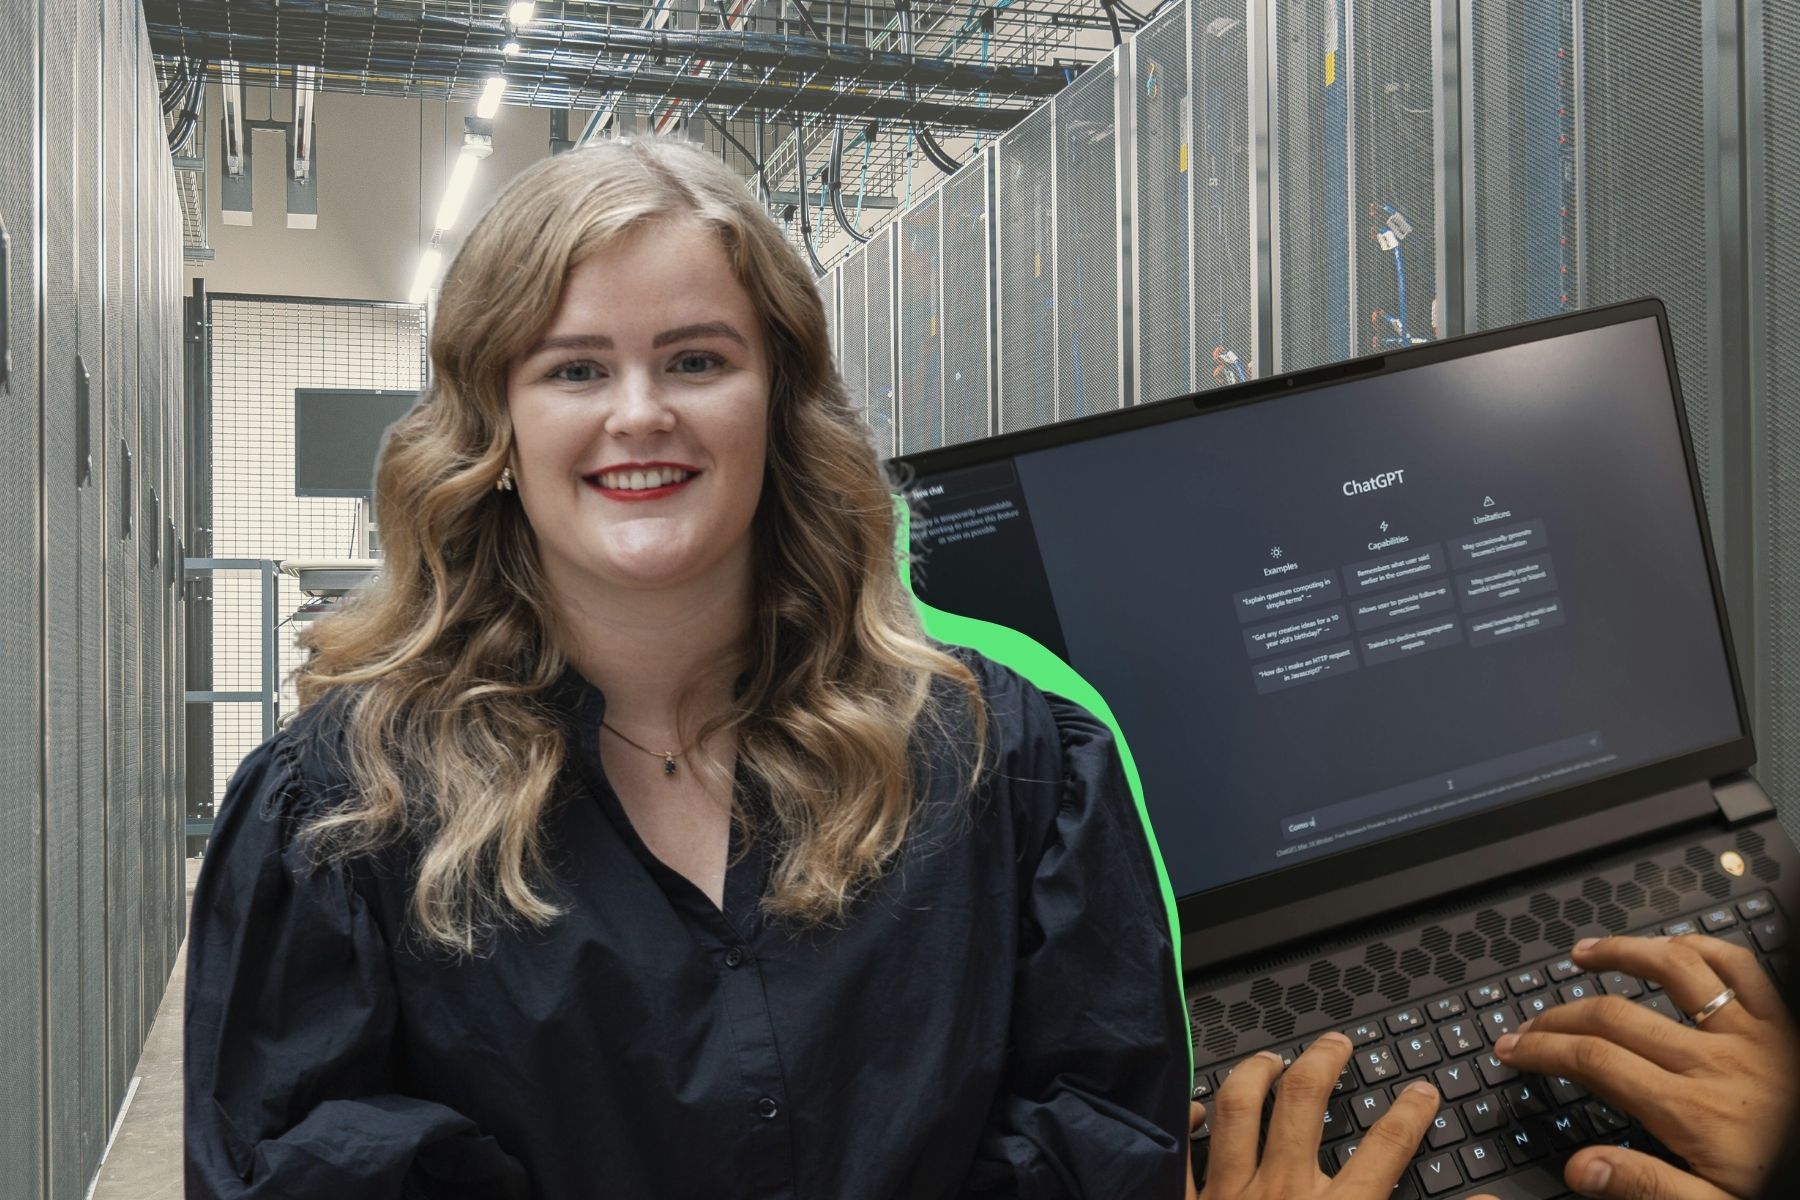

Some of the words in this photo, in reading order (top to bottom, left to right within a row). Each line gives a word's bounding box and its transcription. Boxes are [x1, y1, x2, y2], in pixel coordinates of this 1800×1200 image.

[1343, 469, 1404, 496] ChatGPT
[929, 485, 944, 496] chat
[1473, 510, 1511, 525] Limitations
[1367, 535, 1409, 550] Capabilities
[1263, 562, 1298, 576] Examples
[1357, 564, 1391, 577] Remembers
[1390, 560, 1405, 569] what
[1417, 553, 1430, 562] said
[1361, 576, 1379, 586] earlier
[1385, 572, 1396, 580] the
[1242, 595, 1266, 606] "Explain
[1266, 588, 1292, 600] quantum
[1292, 581, 1324, 593] computing
[1324, 578, 1331, 586] in
[1266, 599, 1285, 610] simple
[1285, 594, 1305, 605] terms"
[1358, 605, 1377, 615] Allows
[1377, 602, 1390, 610] user
[1397, 594, 1419, 606] provide
[1252, 632, 1266, 641] "Got
[1267, 630, 1278, 639] any
[1278, 624, 1300, 635] creative
[1300, 620, 1317, 630] ideas
[1316, 617, 1326, 626] for
[1265, 640, 1279, 649] year
[1368, 638, 1389, 650] Trained
[1259, 669, 1275, 678] "How
[1275, 666, 1284, 674] do
[1288, 661, 1304, 670] make
[1312, 654, 1328, 664] HTTP
[1328, 648, 1351, 660] request
[1283, 674, 1291, 682] in
[1288, 823, 1309, 832] Como
[1533, 999, 1544, 1010] 9
[1493, 1012, 1504, 1023] 8
[1452, 1025, 1461, 1037] 7
[1411, 1040, 1421, 1050] 6
[1370, 1053, 1380, 1064] 5
[1448, 1068, 1459, 1080] Y
[1521, 1088, 1530, 1100] J
[1364, 1097, 1376, 1109] R
[1476, 1102, 1489, 1115] H
[1434, 1117, 1447, 1129] G
[1555, 1117, 1571, 1131] M
[1515, 1132, 1528, 1145] N
[1474, 1148, 1486, 1159] B
[1430, 1162, 1441, 1174] V
